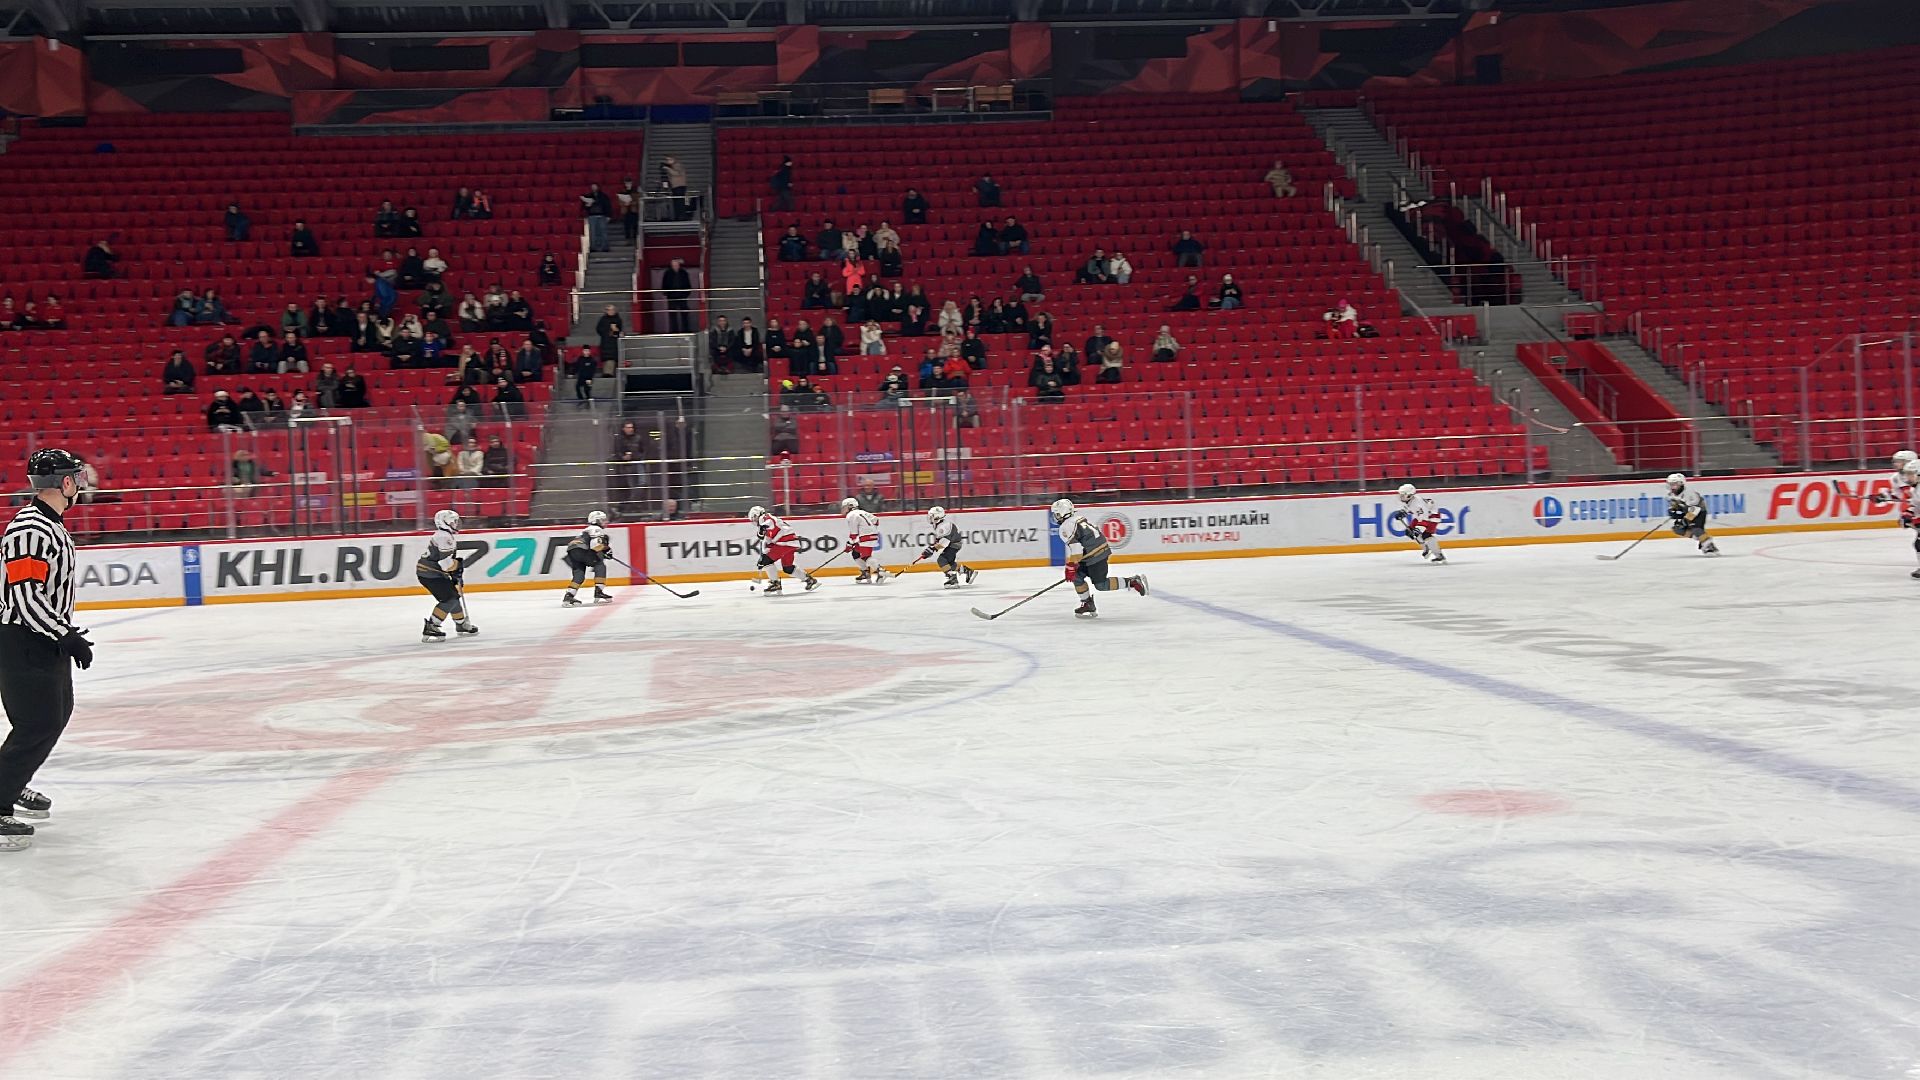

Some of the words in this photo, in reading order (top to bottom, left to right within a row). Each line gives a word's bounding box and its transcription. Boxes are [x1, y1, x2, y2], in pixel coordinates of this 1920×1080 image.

[1137, 515, 1203, 532] БИЛЕТЫ
[1207, 510, 1271, 528] ОНЛАЙН
[1352, 503, 1470, 539] Haer
[660, 533, 839, 560] ТИНЬКФФ
[1161, 531, 1241, 545] HCVITYAZ.RU
[76, 562, 159, 588] ADA
[216, 542, 404, 588] KHL.RU
